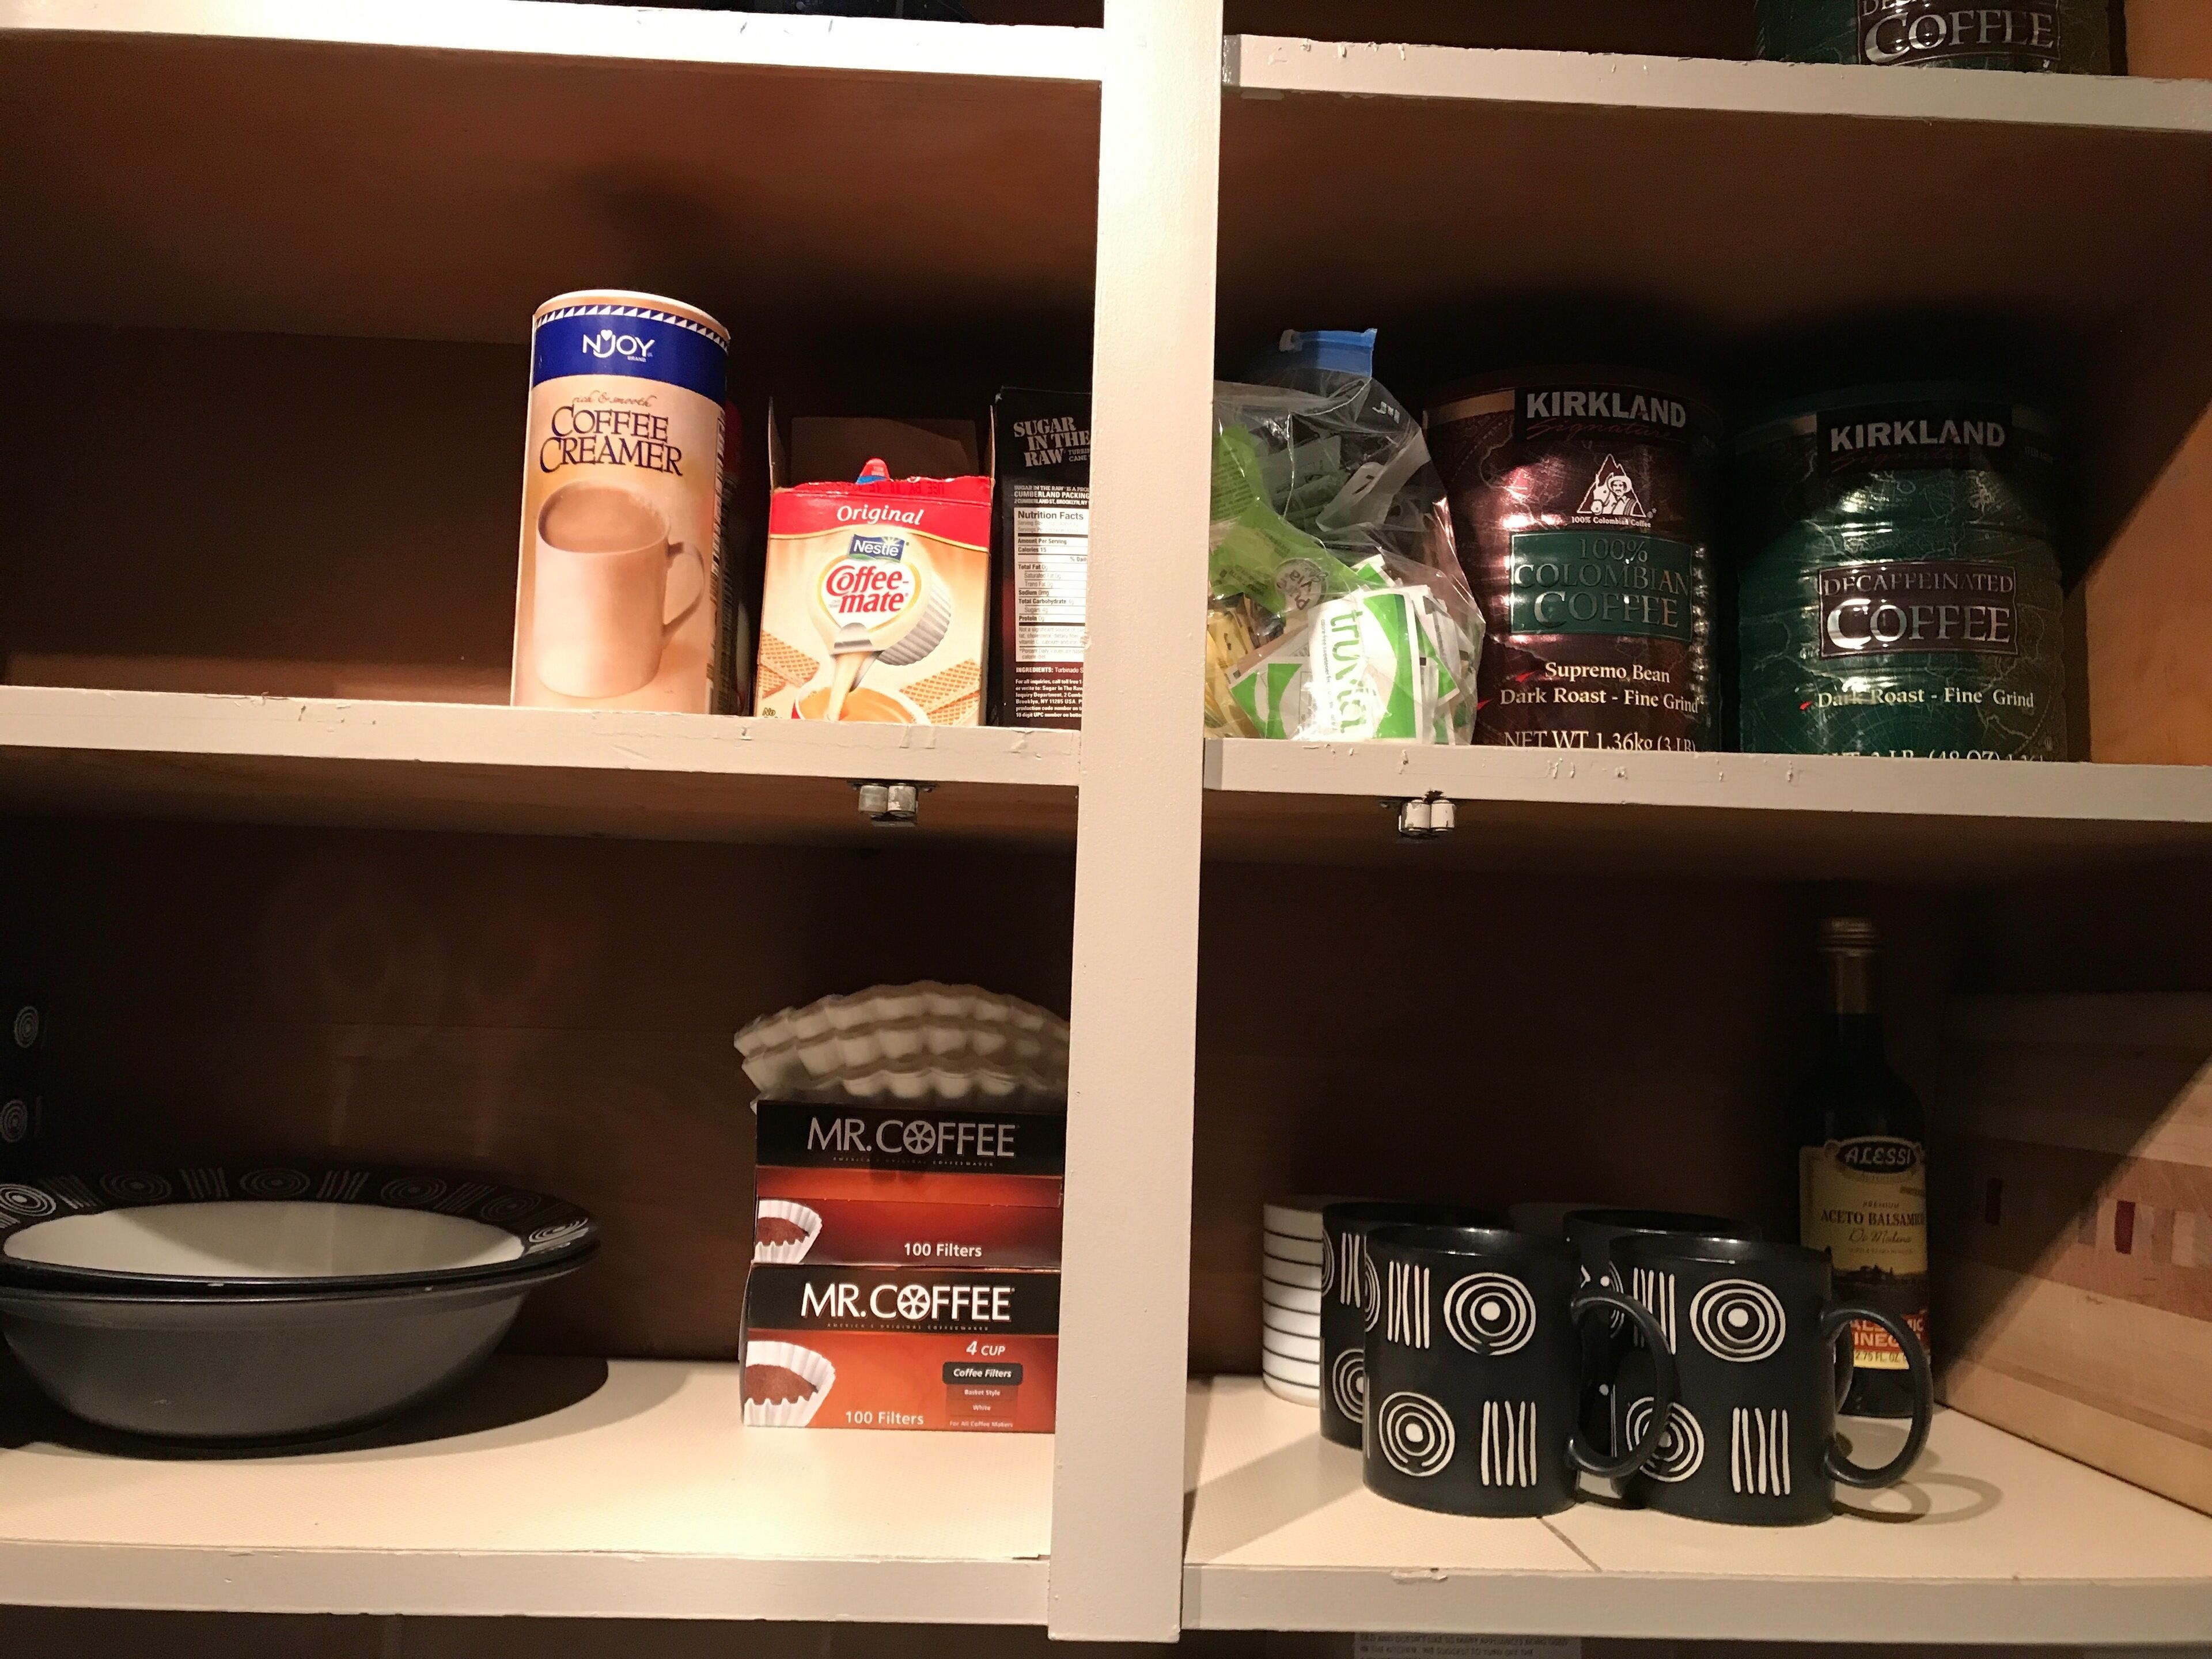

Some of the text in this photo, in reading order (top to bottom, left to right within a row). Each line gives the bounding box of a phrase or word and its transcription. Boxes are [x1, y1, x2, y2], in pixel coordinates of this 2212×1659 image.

[1865, 9, 2054, 63] COFFEE
[1527, 391, 1686, 428] KIRKLAND
[551, 404, 669, 442] COFFEE
[1013, 416, 1077, 438] SUGAR
[1027, 430, 1090, 451] IN THE
[1831, 419, 2005, 452] KIRKLAND
[540, 436, 683, 476] CREAMER
[1024, 448, 1064, 468] RAW
[837, 505, 925, 525] Original
[1017, 510, 1084, 520] Nutrition Facts
[1571, 516, 1652, 528] 100% Colombian Coffee
[1581, 537, 1647, 563] 100%
[1514, 563, 1691, 598] COLOMBIAN
[1823, 573, 2013, 596] DECAFFEINATED
[839, 591, 904, 614] mate
[1534, 590, 1679, 629] COFFEE
[1826, 598, 2010, 651] COFFEE
[1544, 661, 1671, 684] Supremo Bean
[1500, 687, 1699, 714] Dark Roast Fine Grind
[1818, 687, 2035, 709] Dark Roast Fine Grind
[762, 707, 777, 717] No
[1551, 730, 1590, 749] WT
[807, 1116, 1016, 1157] MR. COFFEE
[1845, 1146, 1911, 1165] ALESSI
[1820, 1209, 1864, 1225] ACETO
[904, 1243, 982, 1258] 100 Filters
[801, 1282, 1012, 1321] MR. COFFEE
[965, 1340, 1006, 1357] 4 CUP
[953, 1368, 1012, 1378] Coffee Filters
[844, 1411, 925, 1426] 100 Filters
